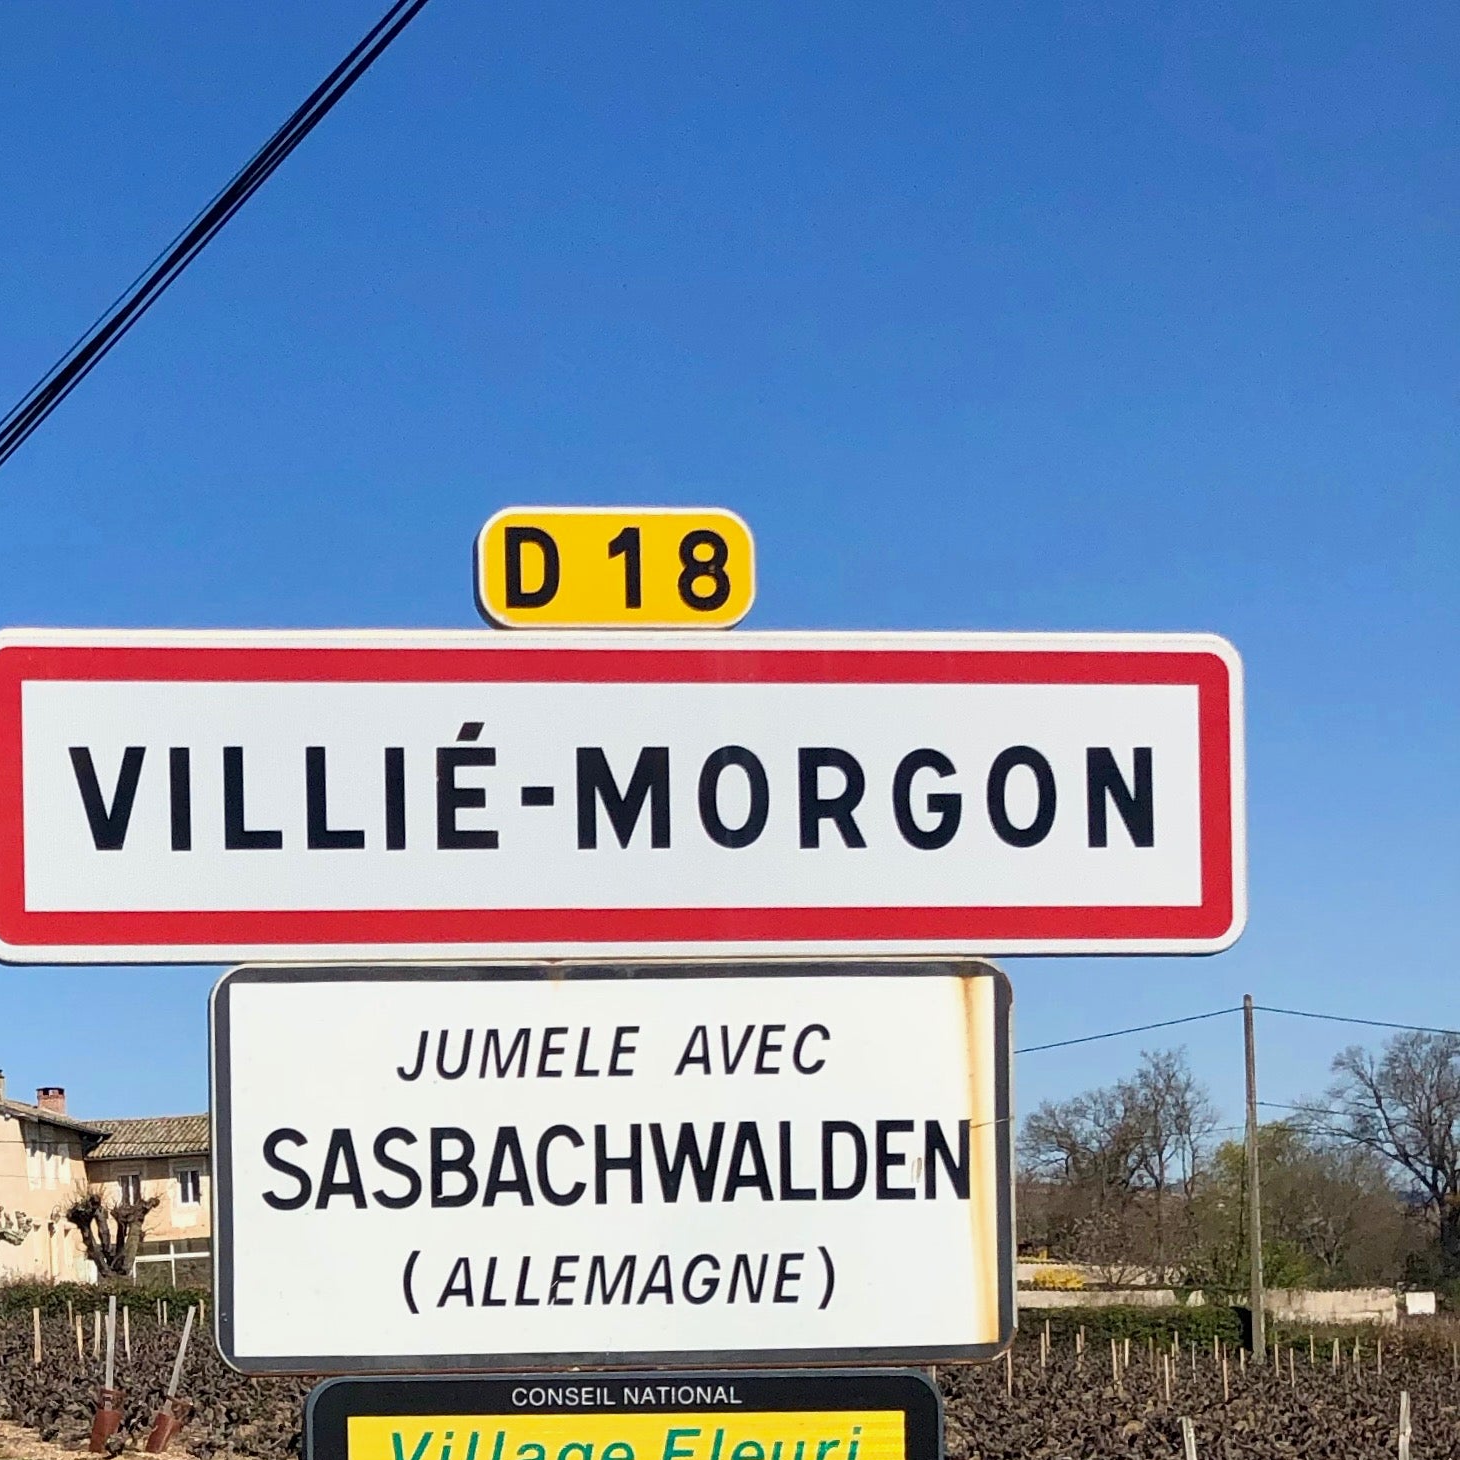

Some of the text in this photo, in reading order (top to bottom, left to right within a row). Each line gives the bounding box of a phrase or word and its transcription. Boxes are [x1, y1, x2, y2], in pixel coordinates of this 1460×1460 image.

[504, 526, 731, 612] D 18
[68, 721, 1154, 852] VILLIÉ-MORGON
[396, 1023, 831, 1082] JUMELE AVEC
[261, 1119, 971, 1211] SASBACHWALDEN
[402, 1246, 836, 1314] (ALLEMAGNE)
[511, 1385, 743, 1407] CONSEIL NATIONAL
